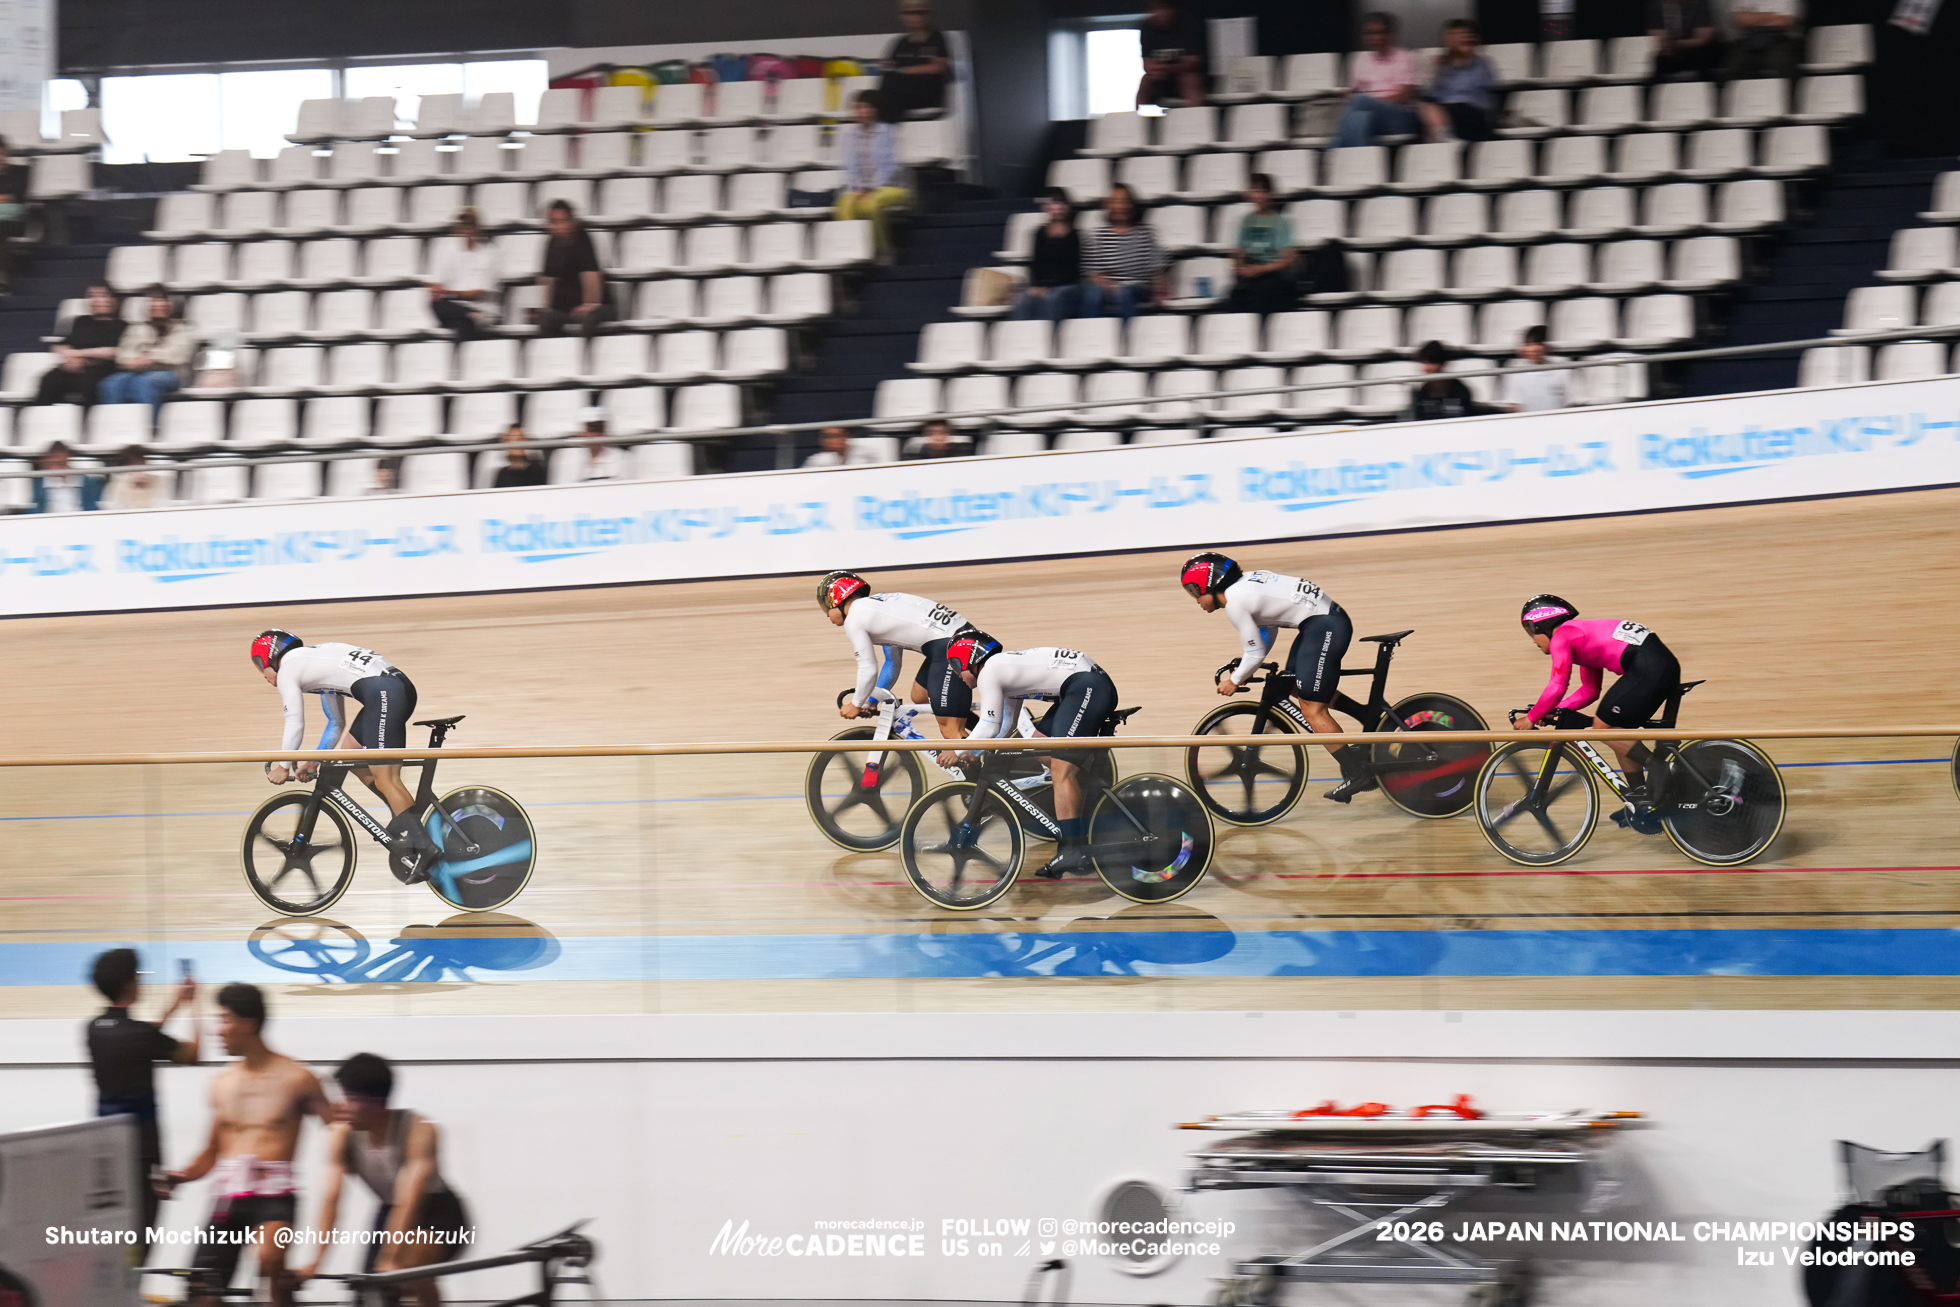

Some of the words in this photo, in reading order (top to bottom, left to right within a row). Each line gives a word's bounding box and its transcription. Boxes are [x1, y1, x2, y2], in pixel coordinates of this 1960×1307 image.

[1297, 582, 1321, 599] 104
[1525, 607, 1568, 621] Kabuto
[348, 650, 373, 666] 44
[1574, 740, 1629, 790] OOK
[330, 788, 392, 844] BRIDGESTONE
[996, 779, 1061, 835] BRIDGESTONE
